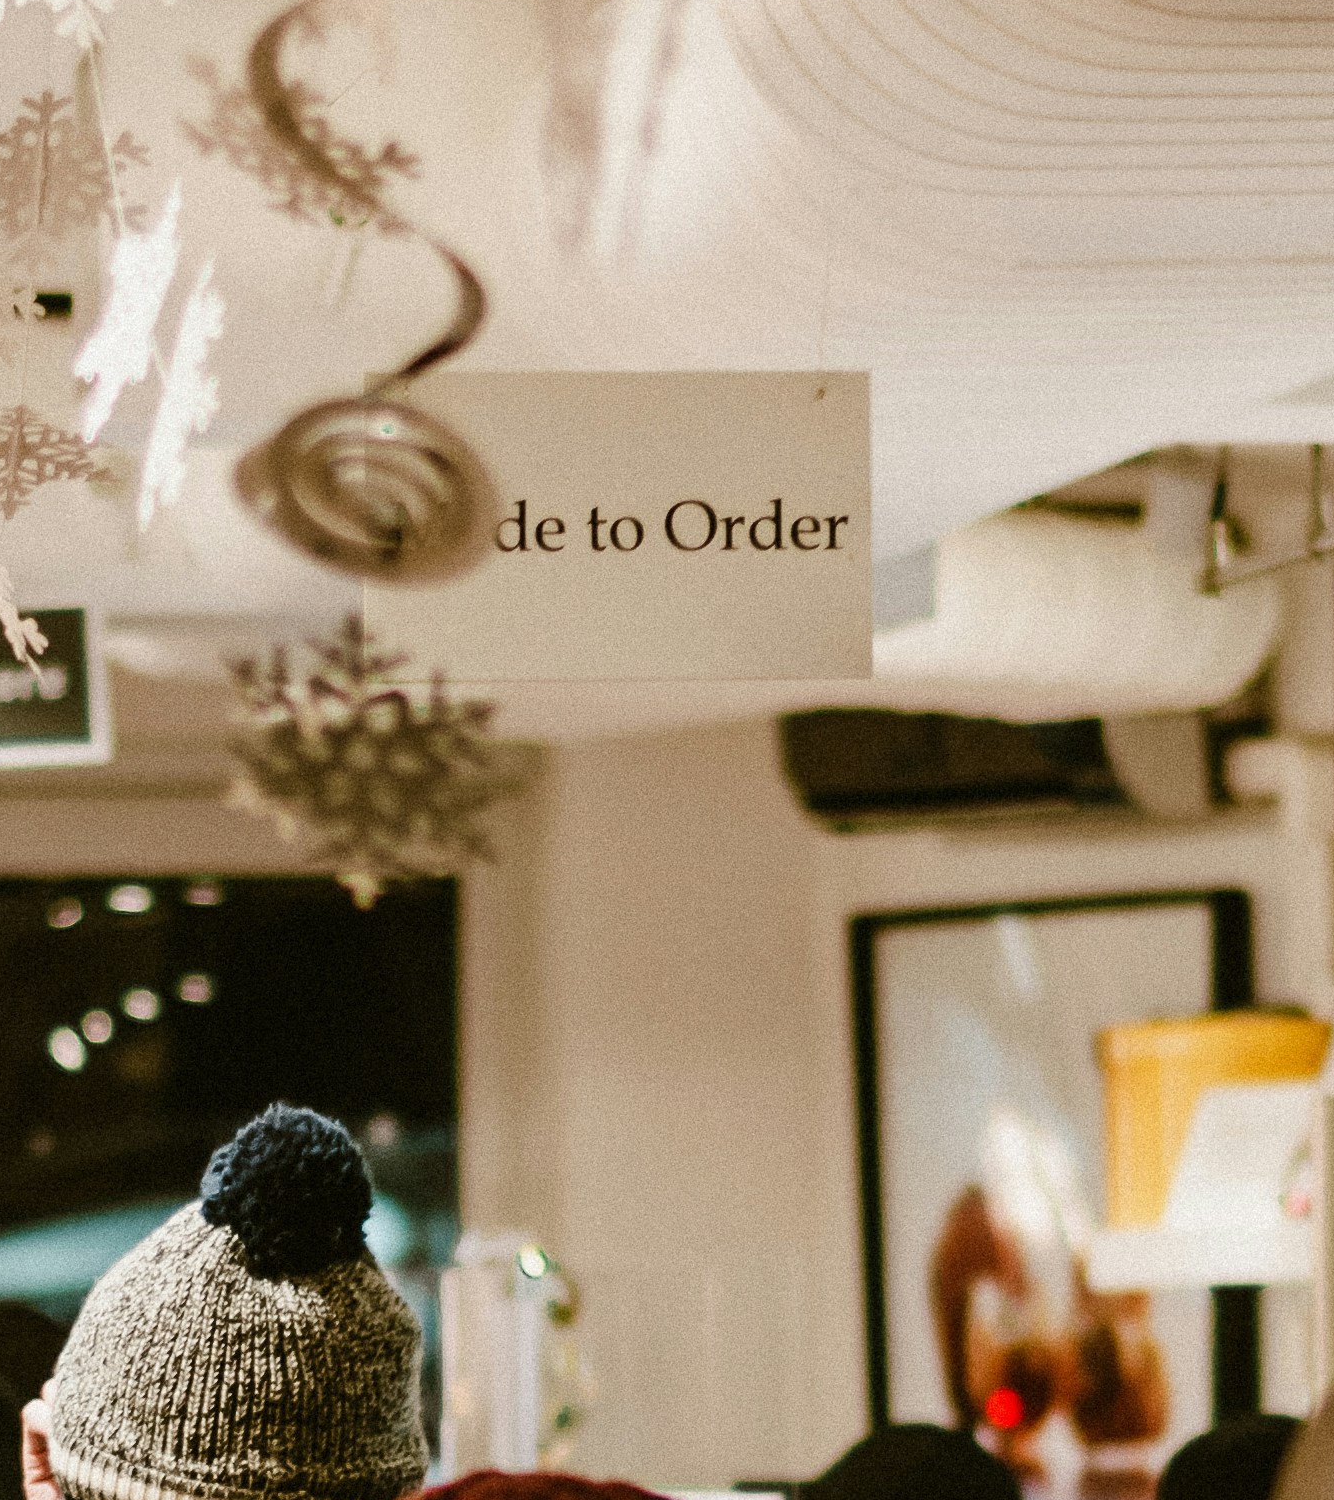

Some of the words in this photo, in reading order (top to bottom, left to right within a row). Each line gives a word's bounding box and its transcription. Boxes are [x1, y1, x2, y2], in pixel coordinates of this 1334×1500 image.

[494, 499, 567, 553] de
[586, 506, 645, 553] to
[664, 497, 849, 553] Order
